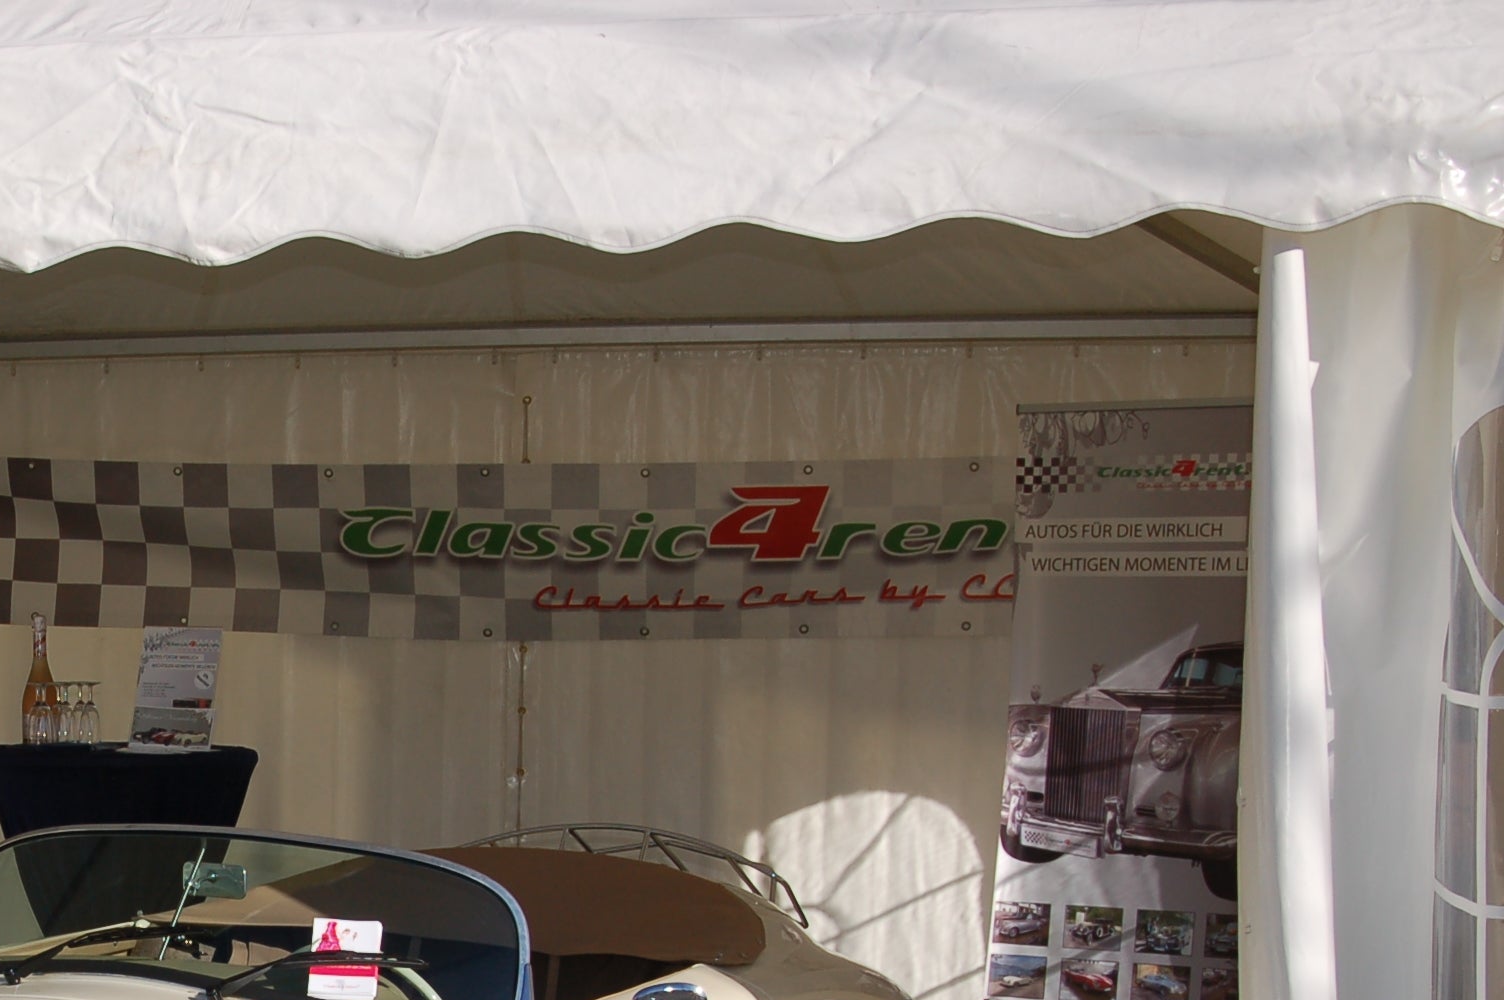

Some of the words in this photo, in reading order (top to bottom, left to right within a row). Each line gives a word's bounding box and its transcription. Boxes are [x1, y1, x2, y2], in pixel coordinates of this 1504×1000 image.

[1025, 524, 1077, 539] AUTOS
[1082, 521, 1112, 538] FÜR
[1117, 524, 1142, 538] DIE
[1146, 522, 1223, 538] WIRKLICH
[1031, 557, 1120, 572] WICHTIGEN
[1125, 557, 1206, 572] MOMENTE
[1212, 557, 1232, 571] IM
[1236, 557, 1248, 571] L
[533, 584, 725, 612] Classic
[738, 584, 864, 609] Cars
[881, 578, 945, 608] by
